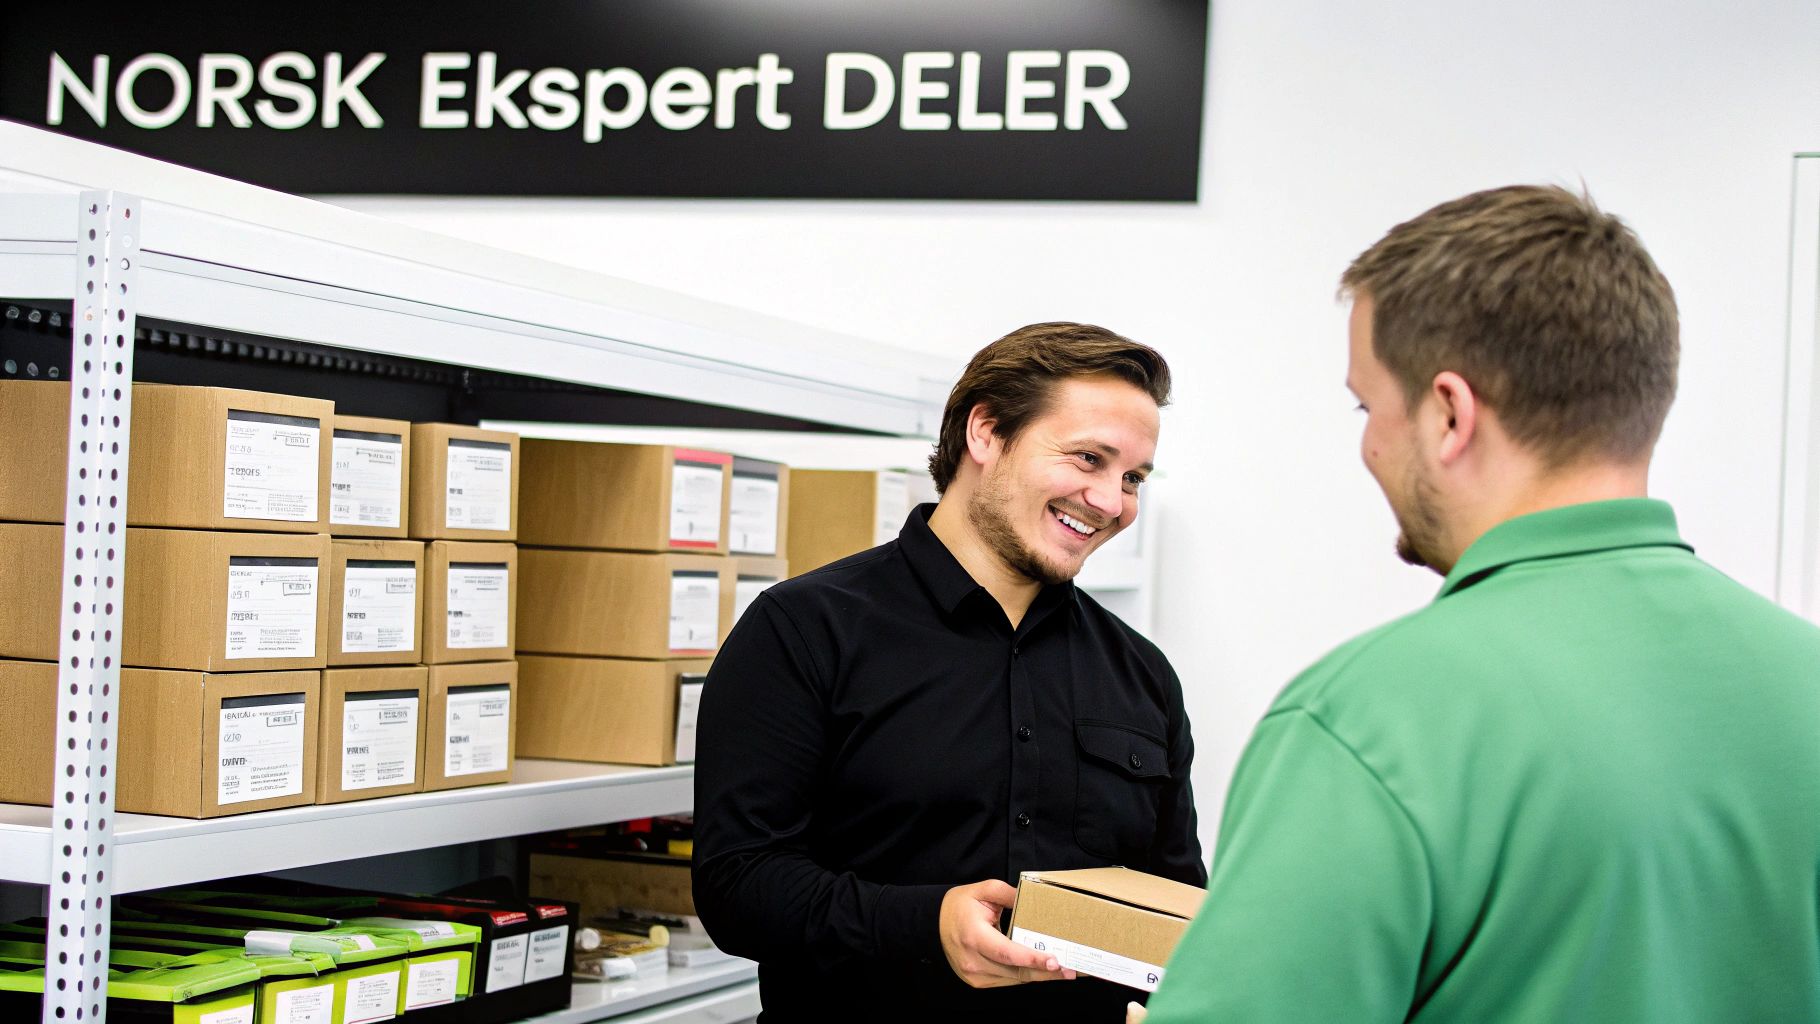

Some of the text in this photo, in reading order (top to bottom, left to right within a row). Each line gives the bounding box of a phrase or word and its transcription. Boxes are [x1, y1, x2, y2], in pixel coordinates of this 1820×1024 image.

[46, 49, 1131, 143] NORSK Ekspert DELER
